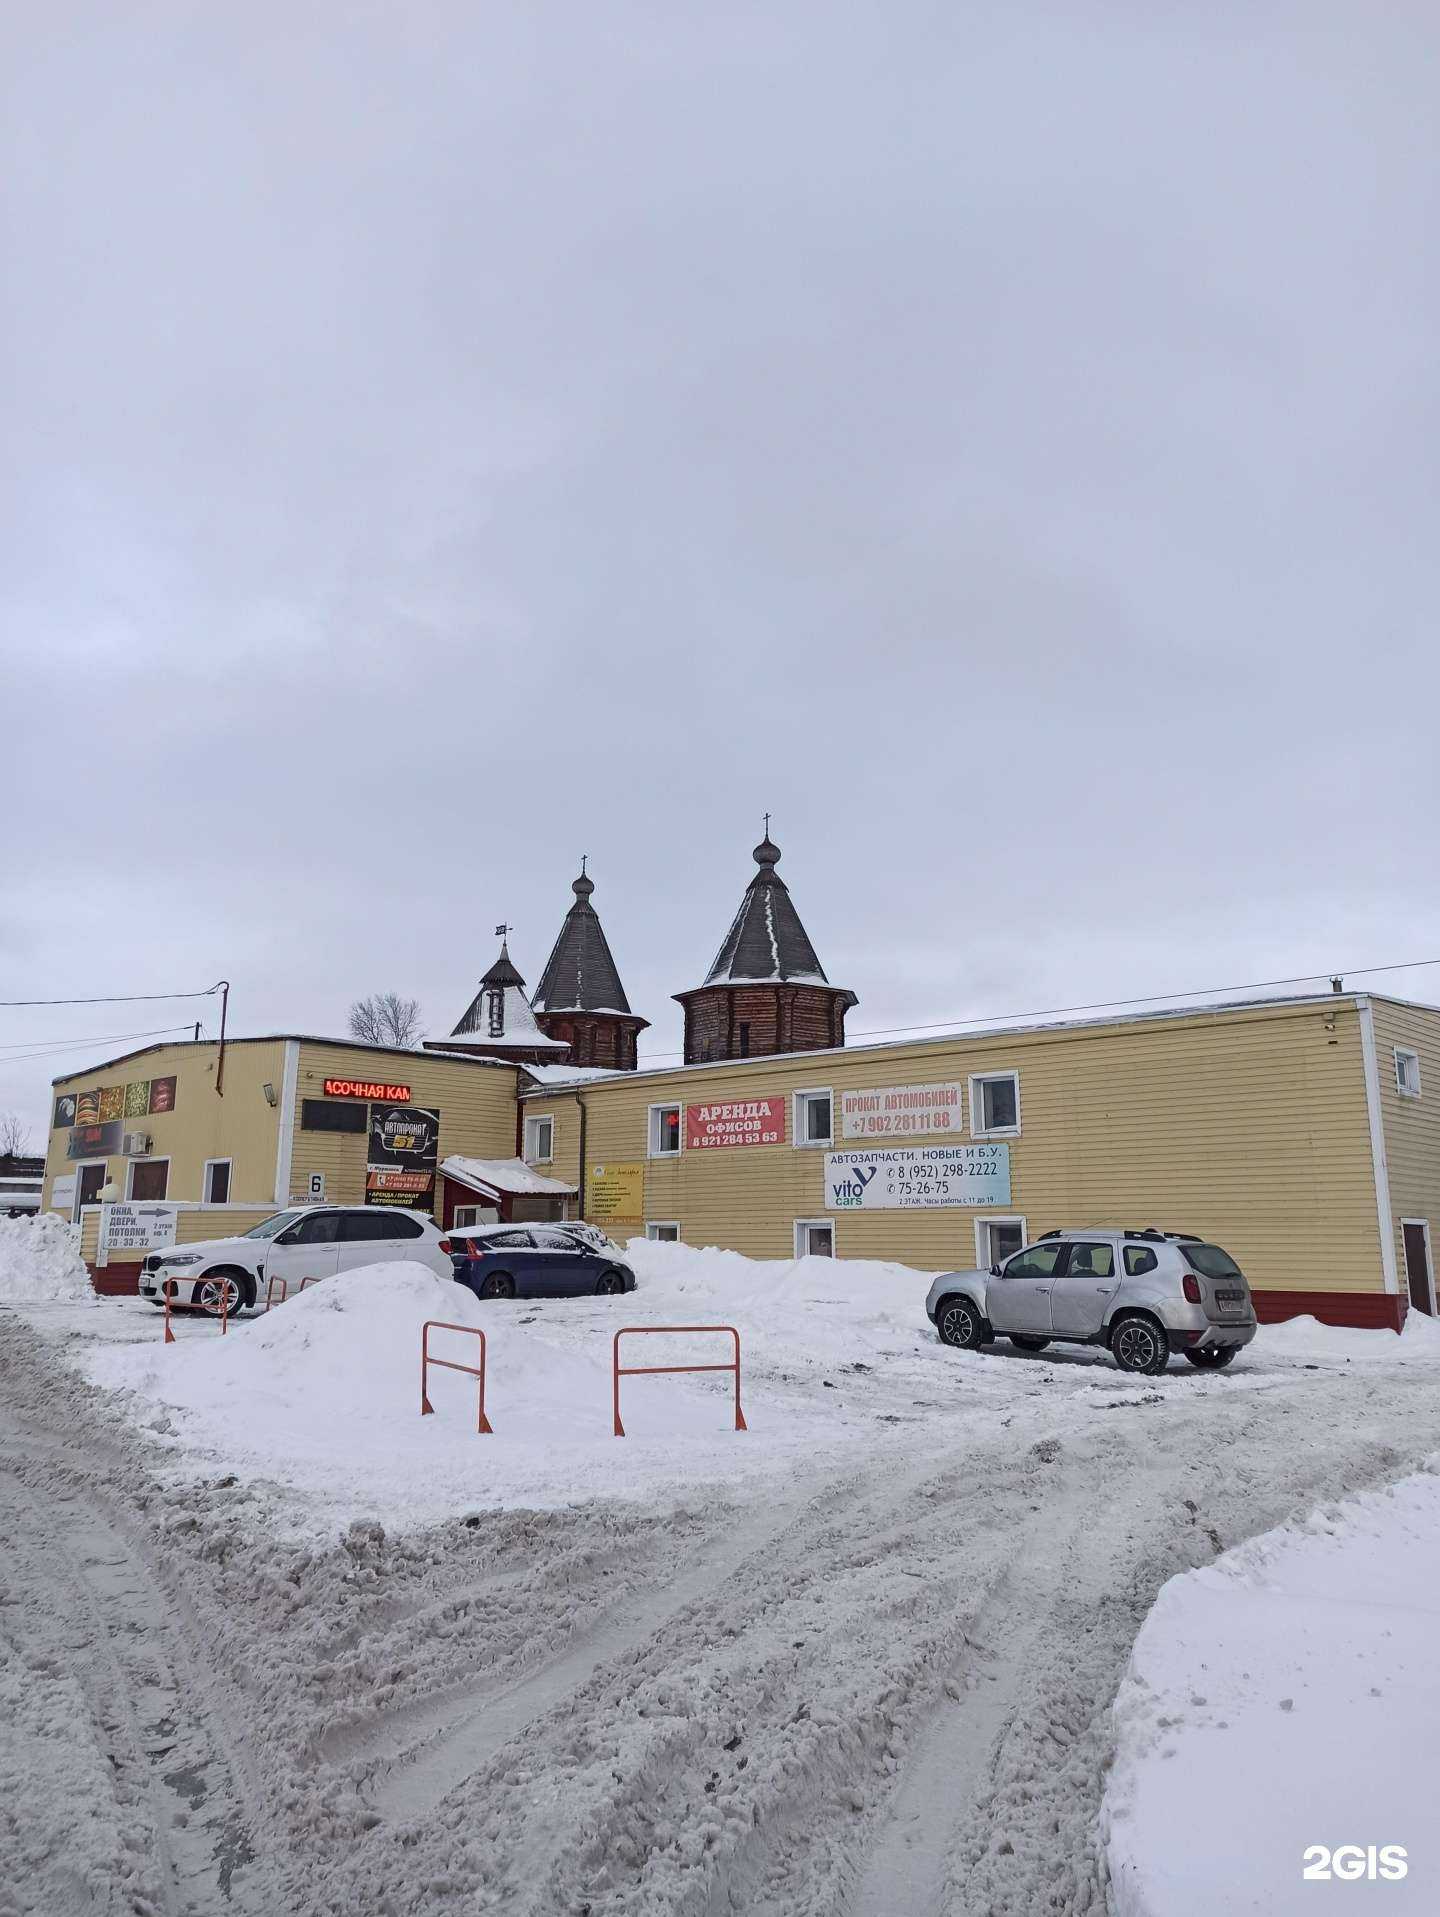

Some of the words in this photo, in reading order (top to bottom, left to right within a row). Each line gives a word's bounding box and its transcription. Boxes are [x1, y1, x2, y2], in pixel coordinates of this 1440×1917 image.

[845, 1095, 881, 1113] ПРОКАТ
[884, 1087, 958, 1110] АВТОМОБИЛЕЙ
[697, 1102, 772, 1121] АРЕНДА
[384, 1121, 427, 1136] АВТОПРОКАТ
[706, 1120, 762, 1134] ОФИСОВ
[852, 1116, 866, 1133] +7
[868, 1115, 892, 1133] 902
[894, 1114, 916, 1131] 281
[919, 1112, 931, 1129] 11
[933, 1111, 950, 1128] 88
[392, 1135, 416, 1149] 51
[693, 1137, 700, 1147] 8
[701, 1135, 721, 1146] 921
[722, 1134, 743, 1145] 284
[745, 1132, 760, 1143] 53
[762, 1131, 778, 1142] 63
[830, 1151, 918, 1165] АВТОЗАПЧАСТИ.
[922, 1149, 962, 1160] НОВЫЕ
[966, 1149, 974, 1158] И
[978, 1147, 1003, 1158] Б.У.
[898, 1167, 905, 1179] 8
[909, 1165, 939, 1180] (952)
[942, 1162, 998, 1177] 298-2222
[311, 1175, 321, 1192] 6
[832, 1180, 864, 1198] vito
[898, 1181, 949, 1195] 75-26-75
[835, 1196, 863, 1206] cars
[940, 1197, 962, 1206] работы
[108, 1227, 146, 1237] ПОТОЛКИ
